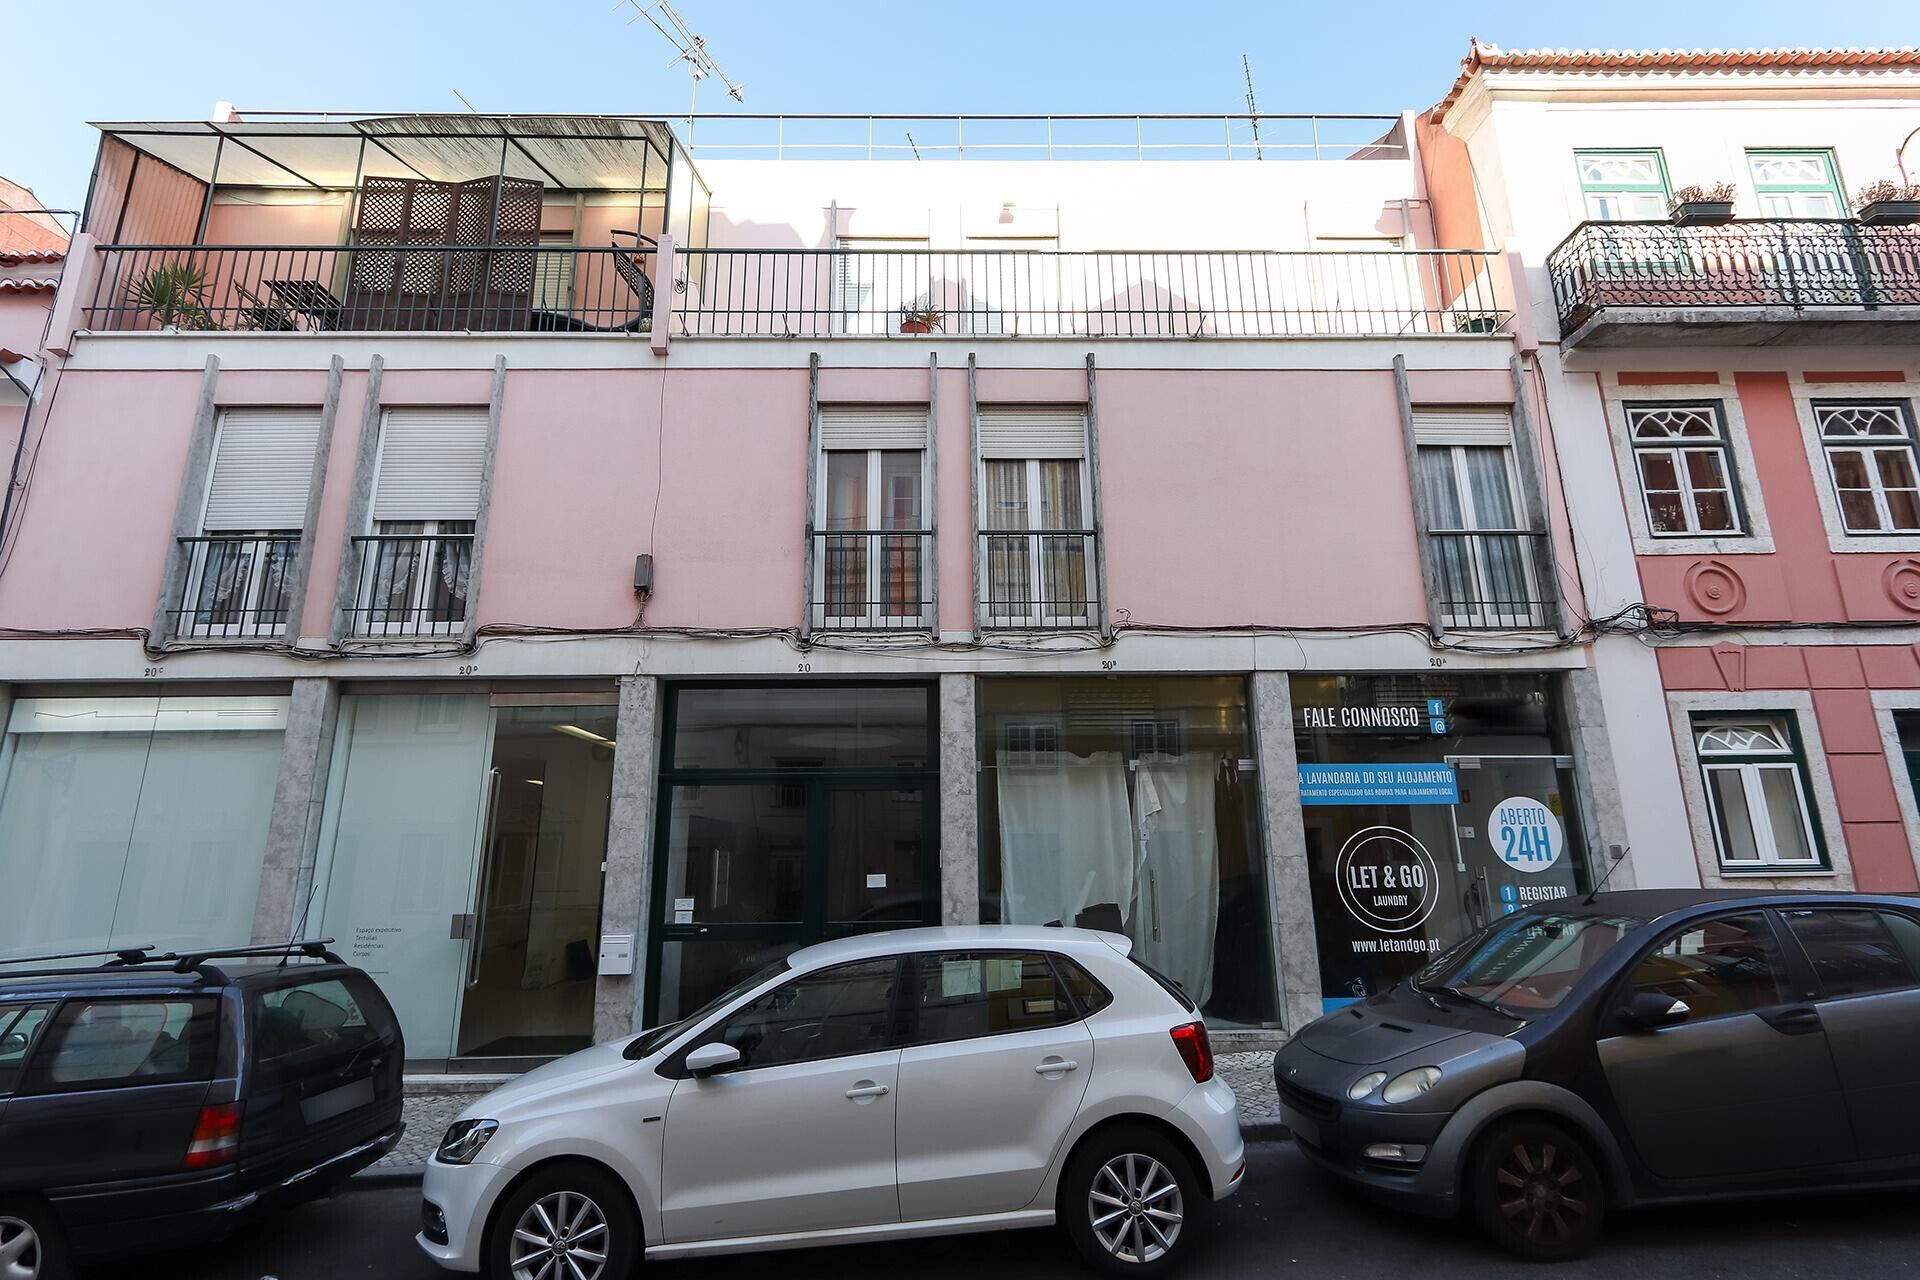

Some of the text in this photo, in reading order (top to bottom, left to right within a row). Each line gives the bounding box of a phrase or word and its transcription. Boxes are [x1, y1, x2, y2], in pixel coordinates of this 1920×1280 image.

[798, 663, 811, 673] 20
[1303, 706, 1420, 728] FALE CONNOSCO
[1298, 770, 1453, 785] A LAVANDARIA DO SEU ALOJAMENTO
[1328, 787, 1363, 797] ESPECIALIZADO
[1394, 787, 1407, 796] PARA
[1408, 787, 1438, 796] ALOJAMENTO
[1439, 787, 1454, 796] LOCAL
[1500, 808, 1546, 825] ABERTO
[1501, 826, 1552, 862] 24H
[1350, 865, 1425, 889] LET & GO
[1373, 895, 1409, 907] LAUNDRY
[1505, 886, 1568, 901] 1 REGISTAR
[1352, 938, 1441, 953] www.letandgo.pt
